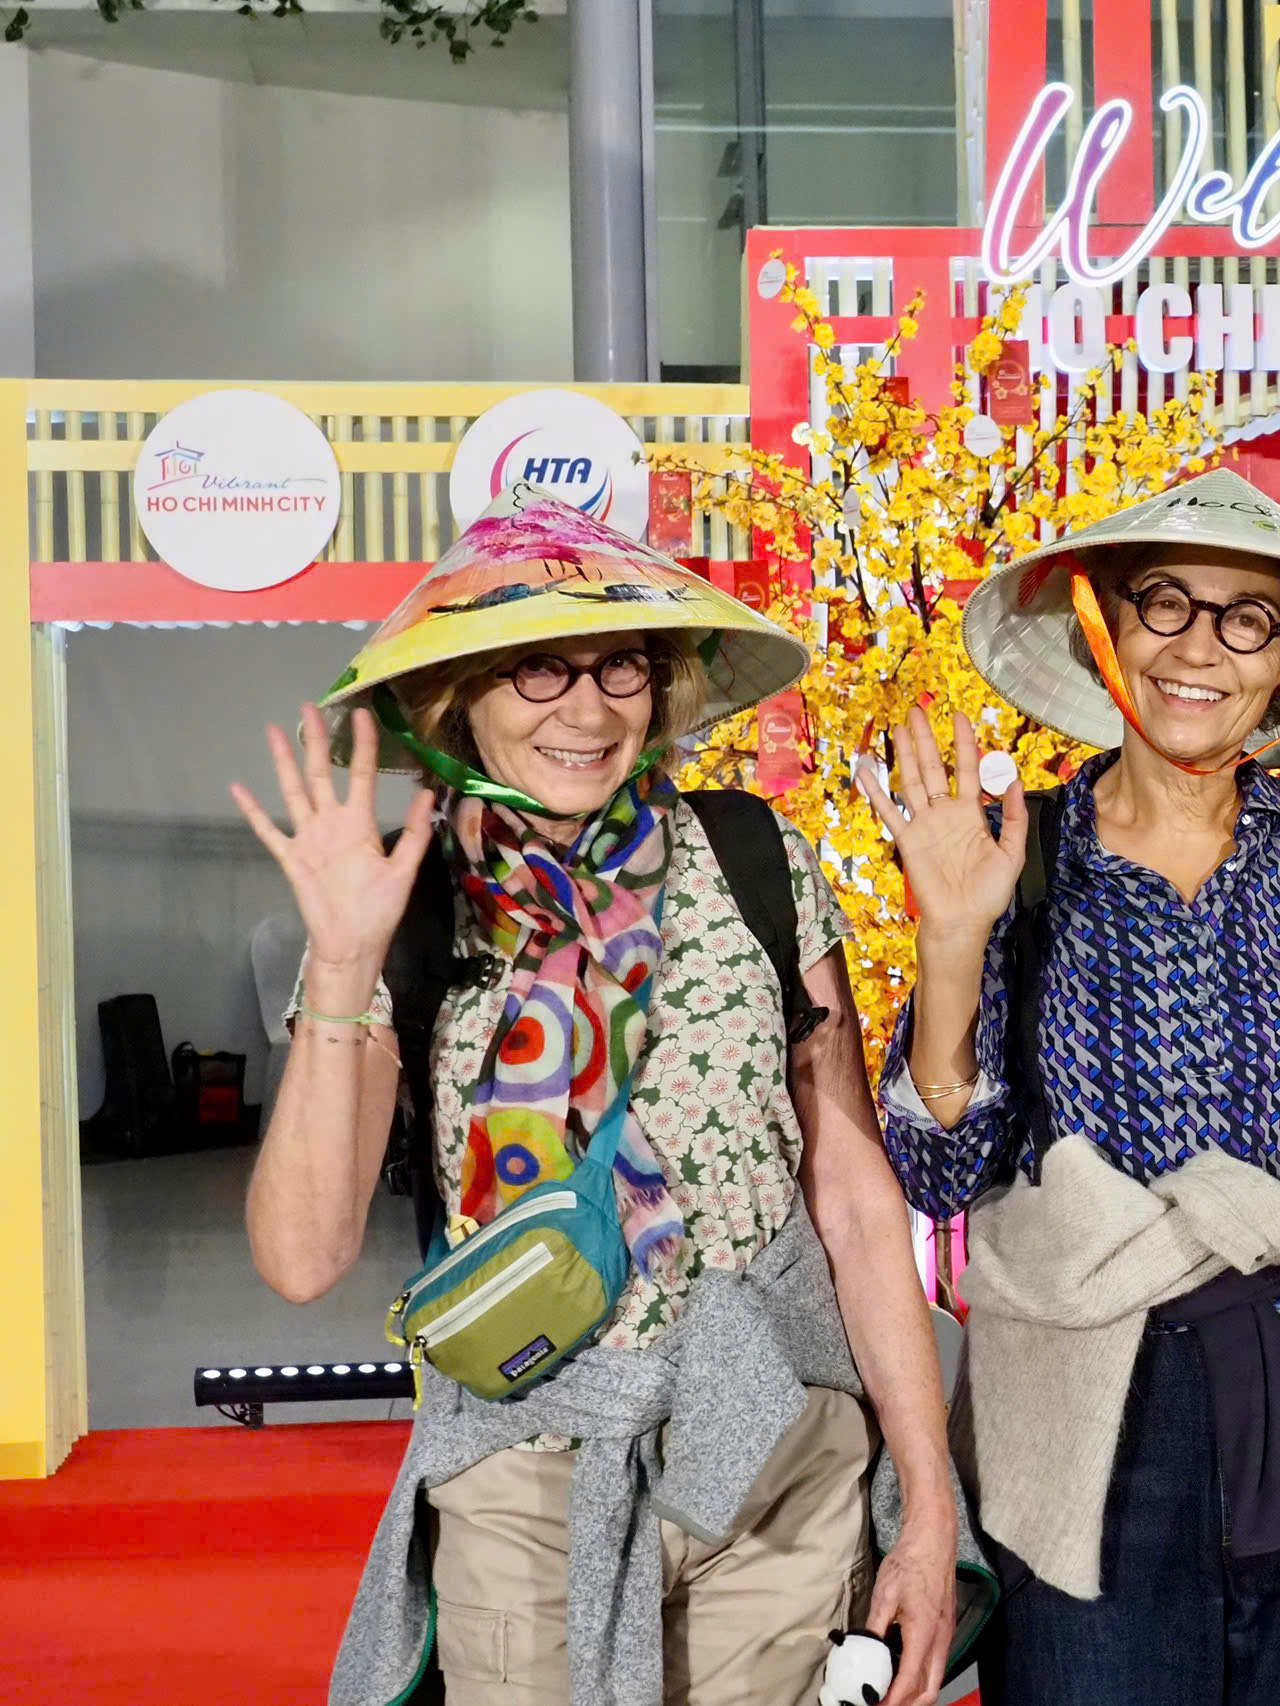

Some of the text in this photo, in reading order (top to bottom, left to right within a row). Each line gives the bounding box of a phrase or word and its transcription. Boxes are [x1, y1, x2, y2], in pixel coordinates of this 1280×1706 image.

[523, 457, 592, 483] HTA
[202, 474, 326, 489] Vibrant
[147, 496, 326, 512] HO CHI MINH CITY
[511, 1347, 549, 1377] patagonia
